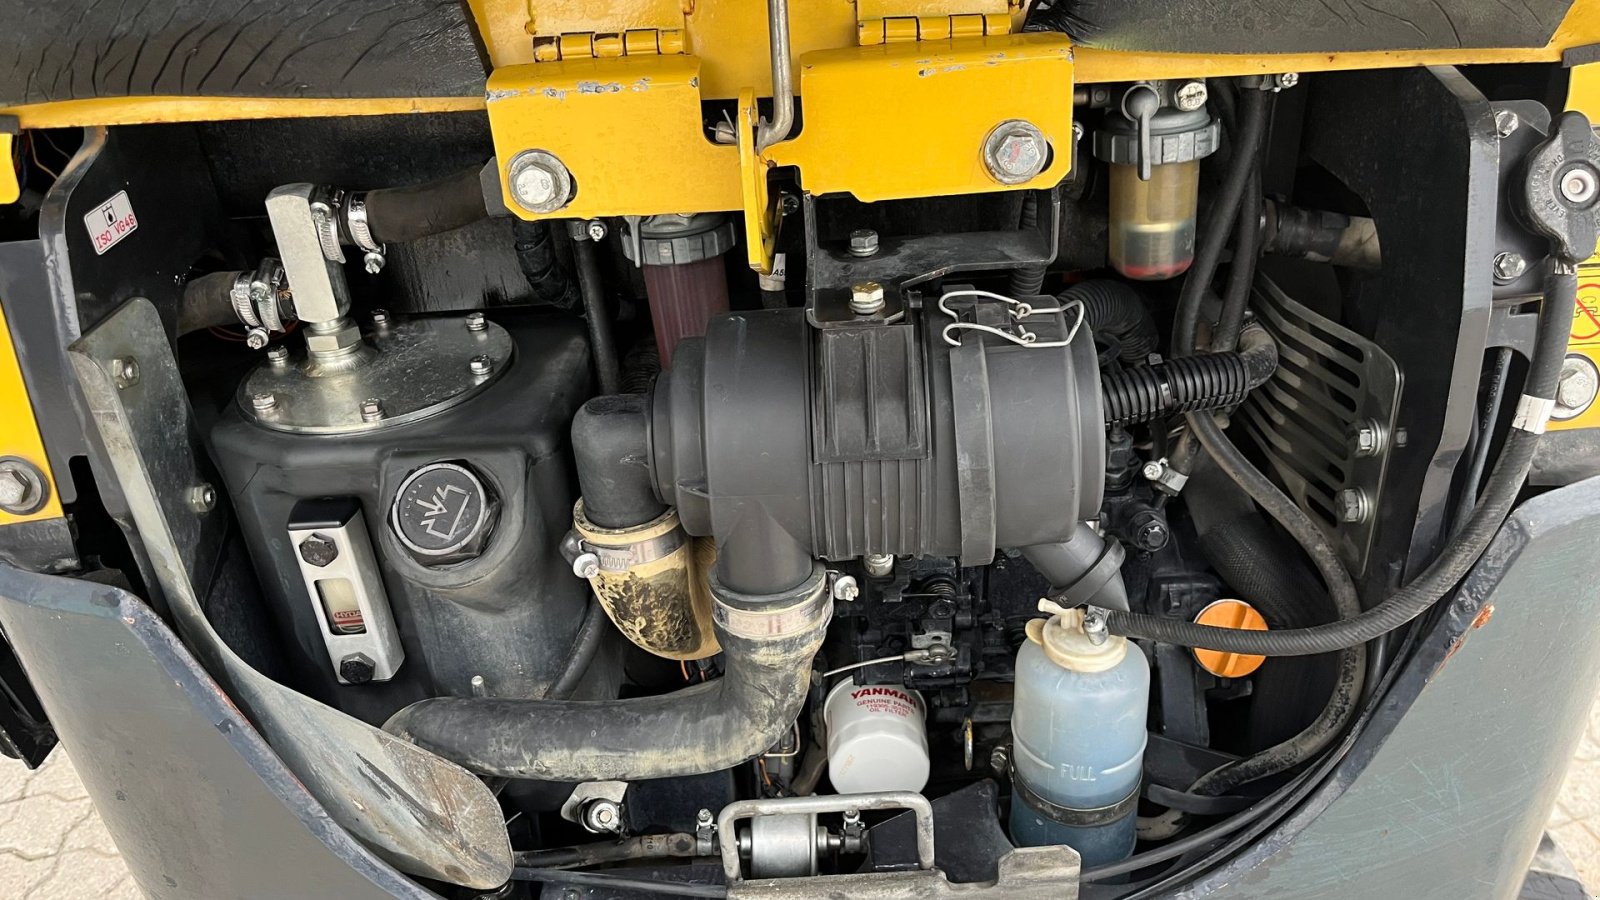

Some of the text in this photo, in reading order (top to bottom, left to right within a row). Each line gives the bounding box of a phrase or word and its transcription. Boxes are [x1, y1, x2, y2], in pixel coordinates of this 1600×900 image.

[96, 214, 135, 248] ISO VG46
[851, 687, 917, 708] YANMAR
[857, 698, 915, 714] GENUINE PARTS
[885, 708, 907, 717] FILTER
[1060, 763, 1096, 781] FULL
